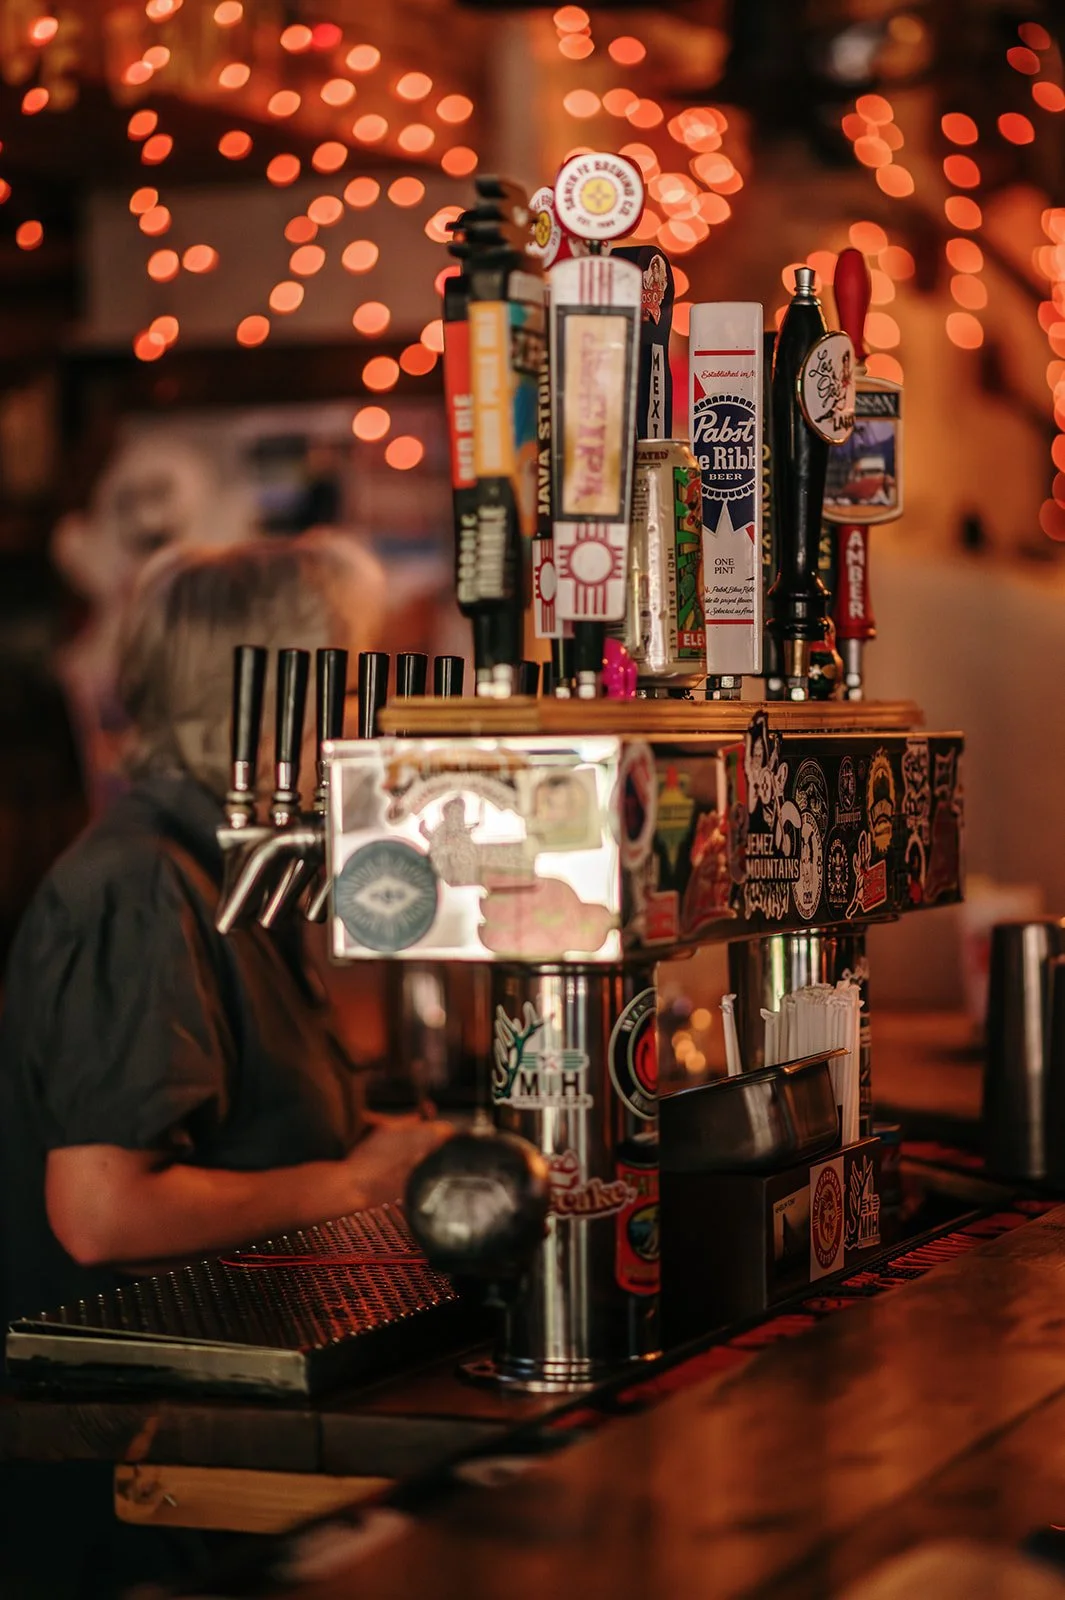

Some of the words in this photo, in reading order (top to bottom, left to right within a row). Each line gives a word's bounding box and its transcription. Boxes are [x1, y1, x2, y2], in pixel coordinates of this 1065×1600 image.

[594, 160, 635, 197] BREWING
[701, 370, 738, 379] Established
[694, 410, 755, 443] Pabst
[538, 448, 550, 516] JAVA
[714, 558, 735, 566] ONE
[846, 530, 864, 619] AMBER
[745, 833, 773, 855] JEMEZ
[745, 858, 799, 879] MOUNTAINS
